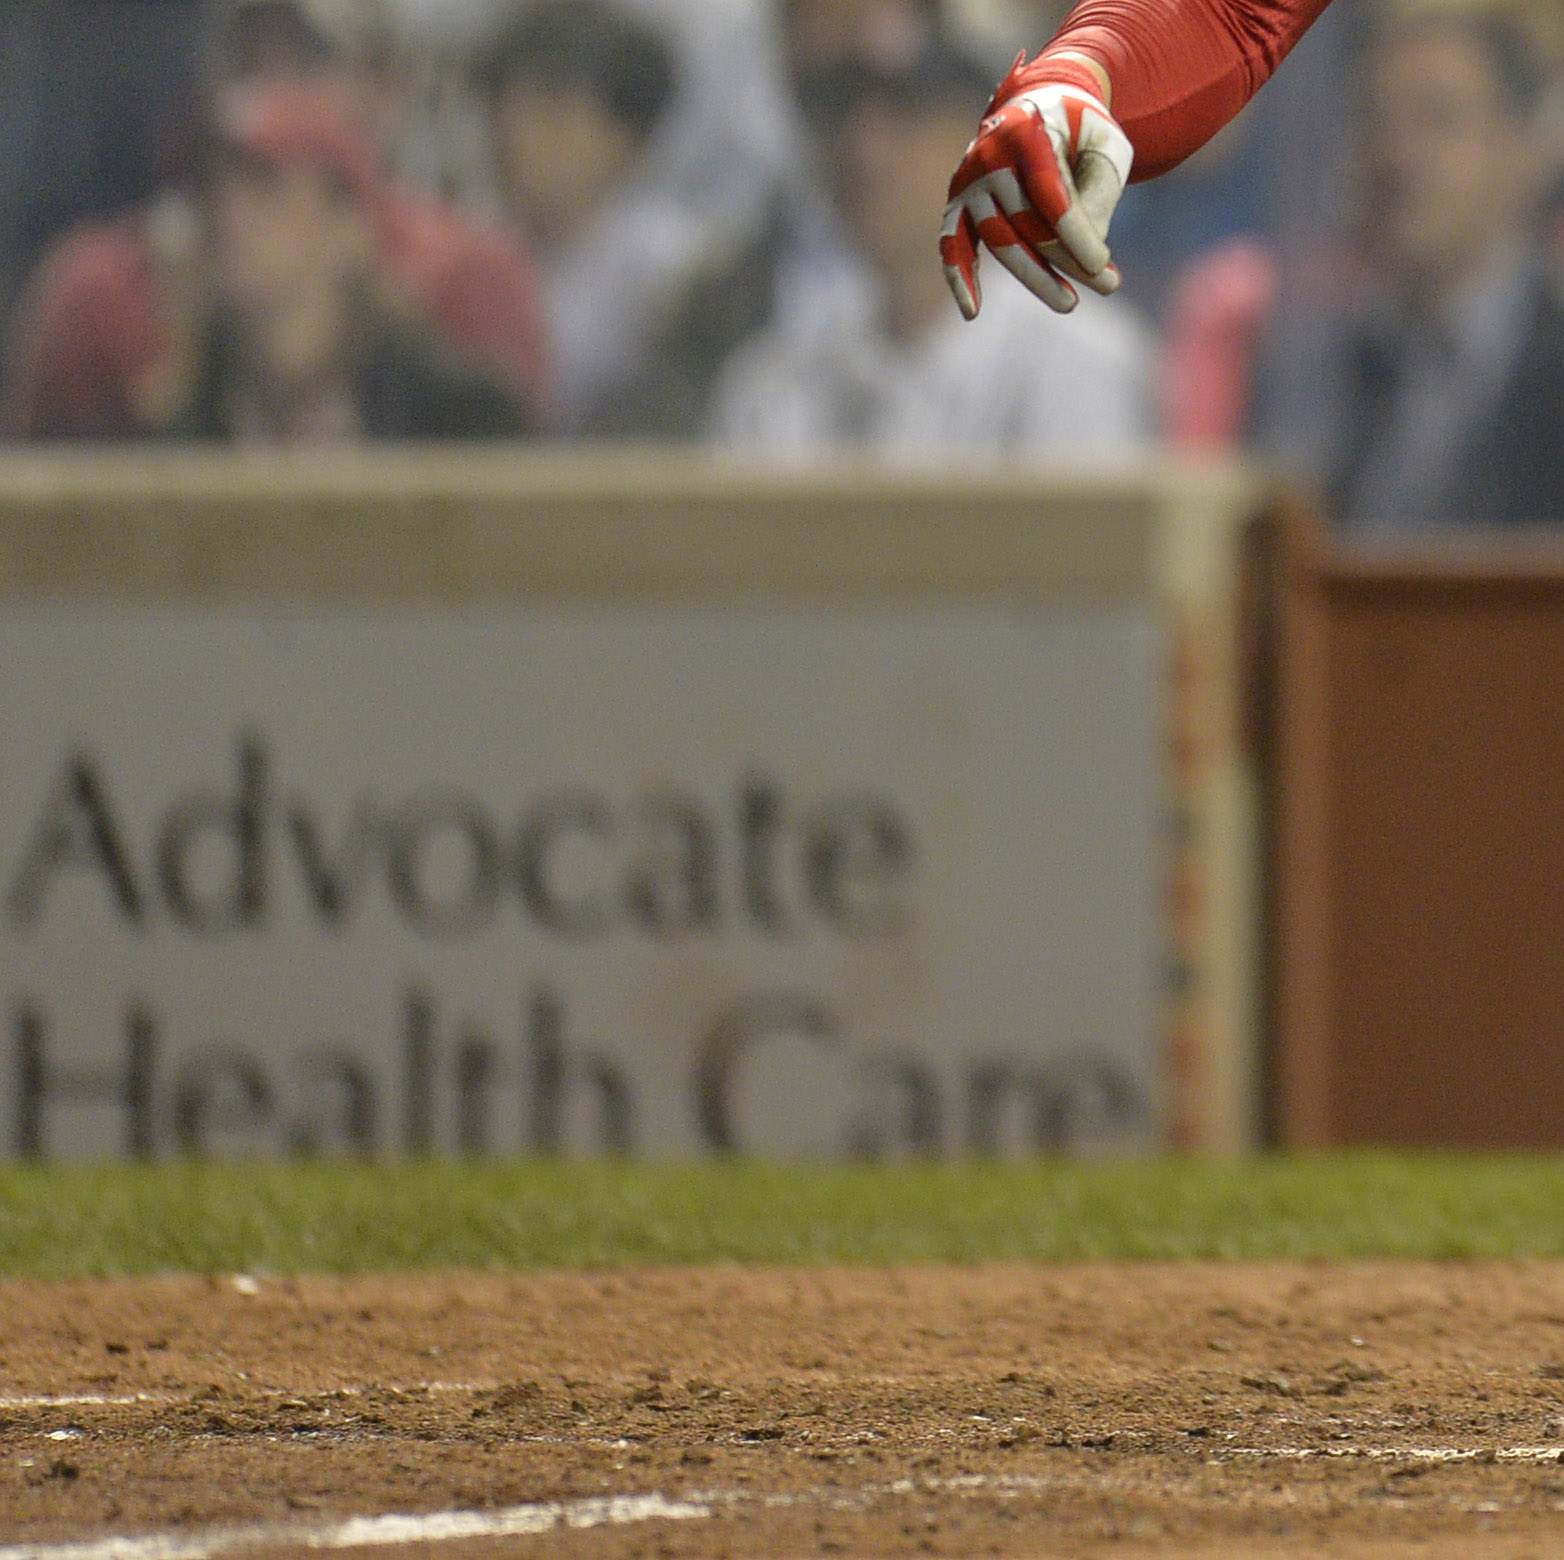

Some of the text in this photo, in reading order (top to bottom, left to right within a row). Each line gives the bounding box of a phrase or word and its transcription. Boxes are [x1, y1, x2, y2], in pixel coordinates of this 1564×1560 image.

[4, 725, 920, 942] Advocate
[10, 980, 1152, 1158] Health Care
